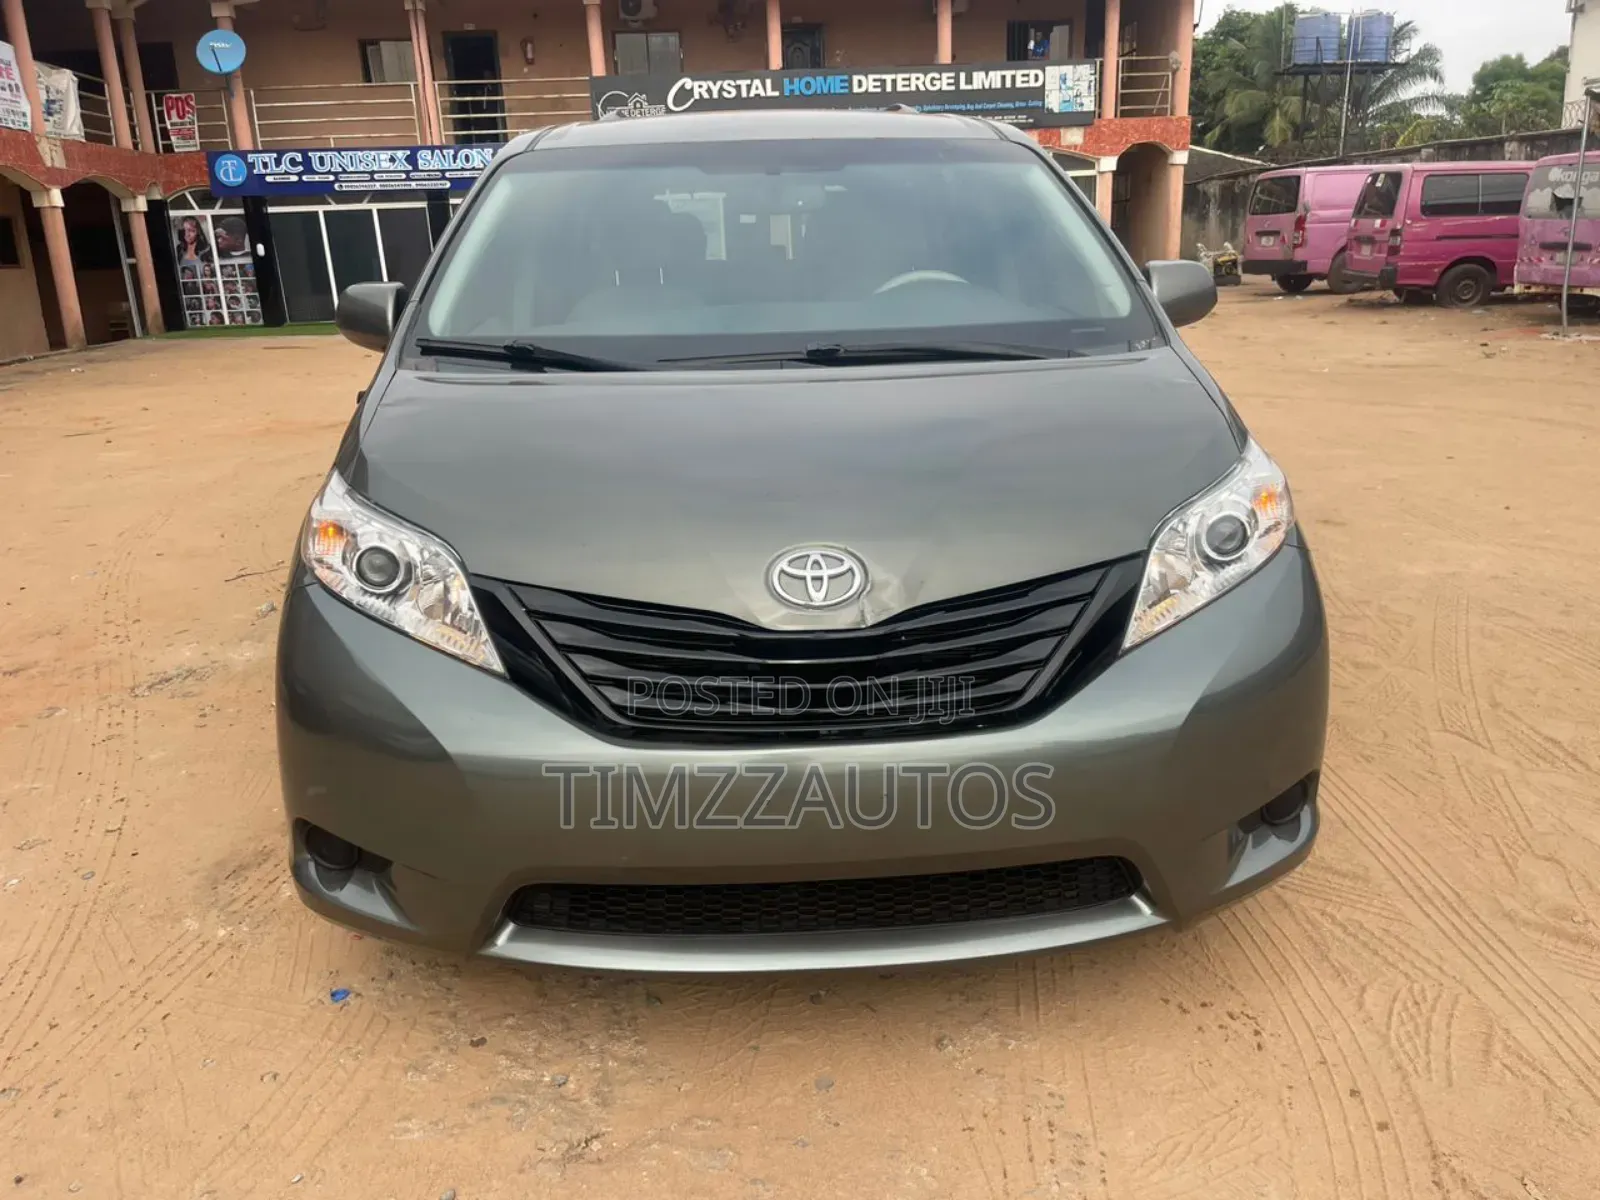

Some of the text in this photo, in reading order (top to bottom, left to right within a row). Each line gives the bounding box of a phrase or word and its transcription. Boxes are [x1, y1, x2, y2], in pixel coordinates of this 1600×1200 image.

[667, 69, 1044, 112] CRYSTAL HOME DETERGE LIMITED
[165, 94, 196, 120] POS
[248, 149, 493, 174] TLC UNISEX SALON
